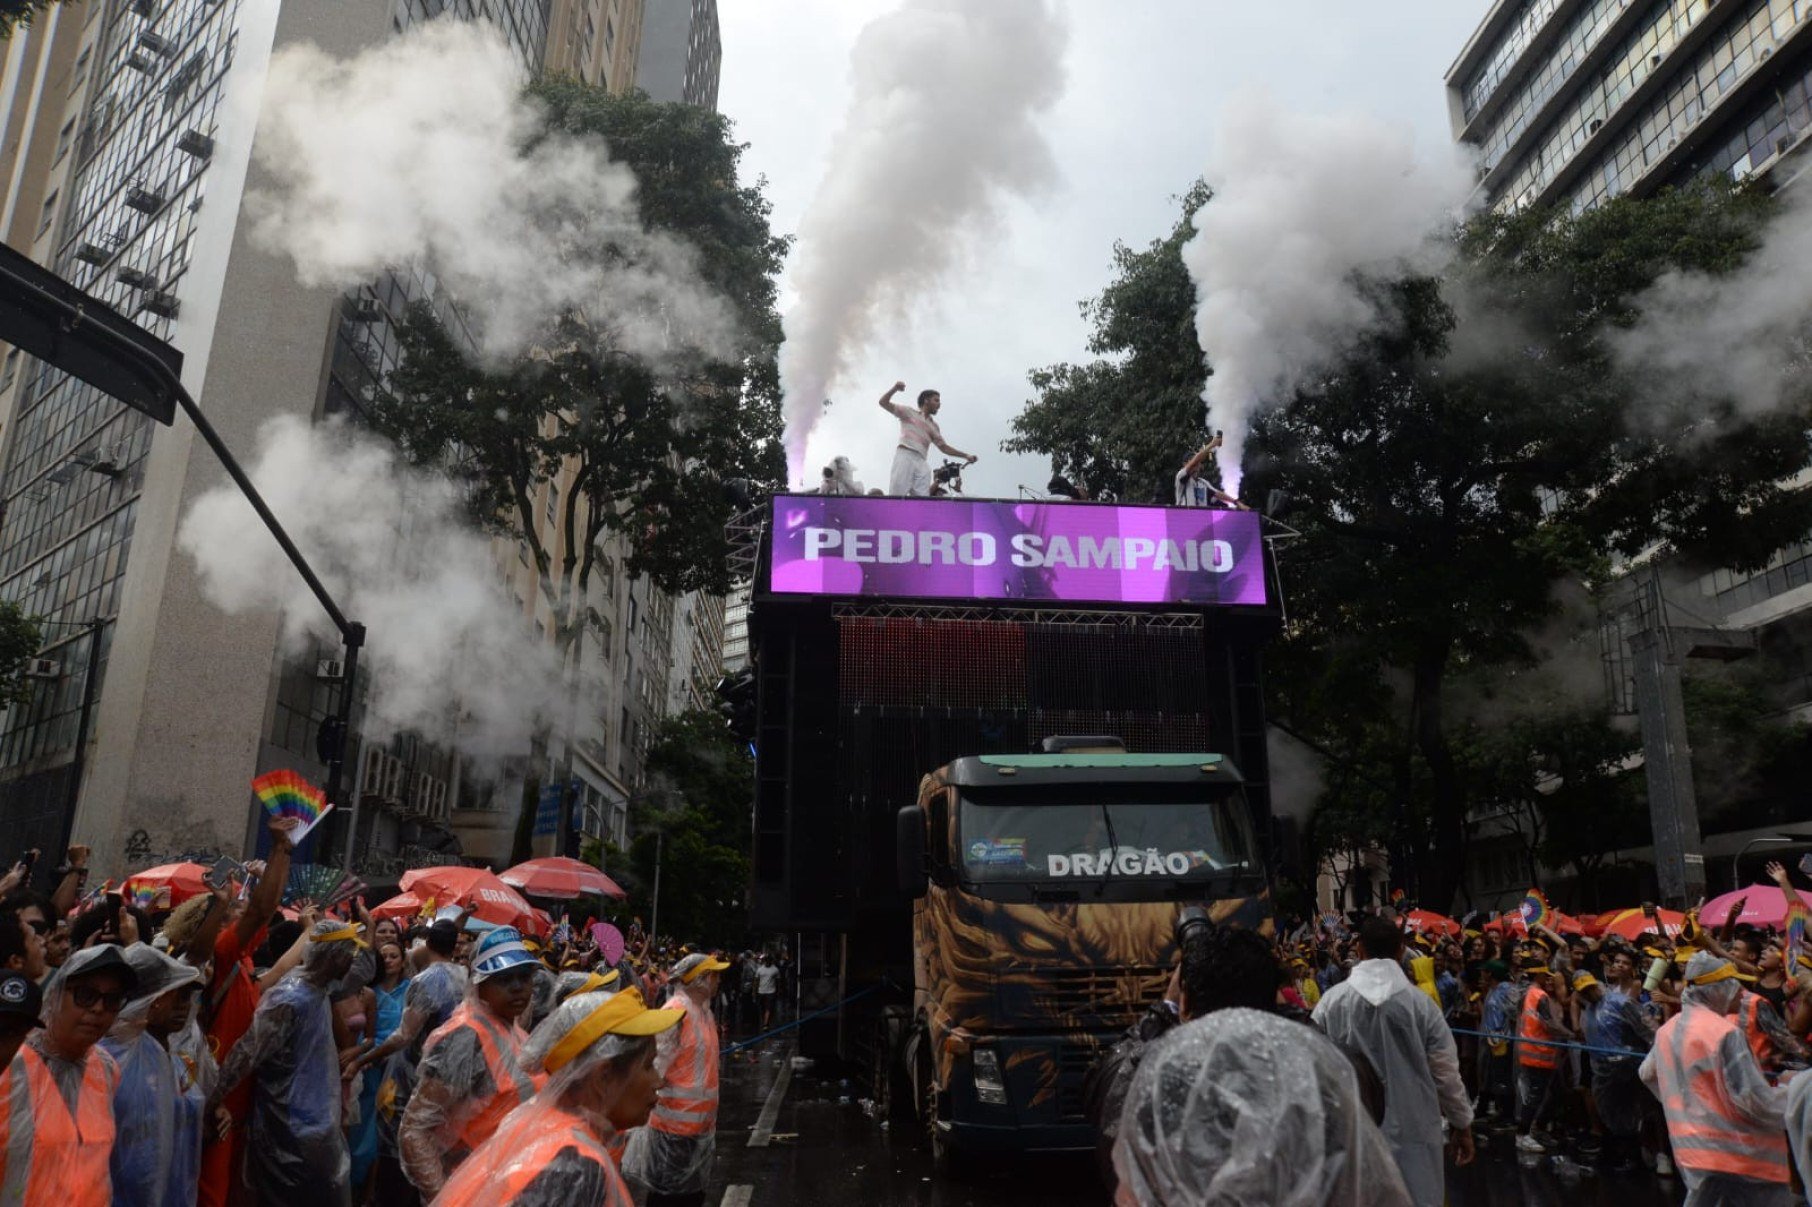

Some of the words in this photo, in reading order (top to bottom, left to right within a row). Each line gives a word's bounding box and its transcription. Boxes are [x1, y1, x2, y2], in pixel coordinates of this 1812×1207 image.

[803, 527, 996, 567] PEDRO
[1011, 534, 1234, 573] SAMPAIO
[1048, 848, 1189, 876] DRAGÃO
